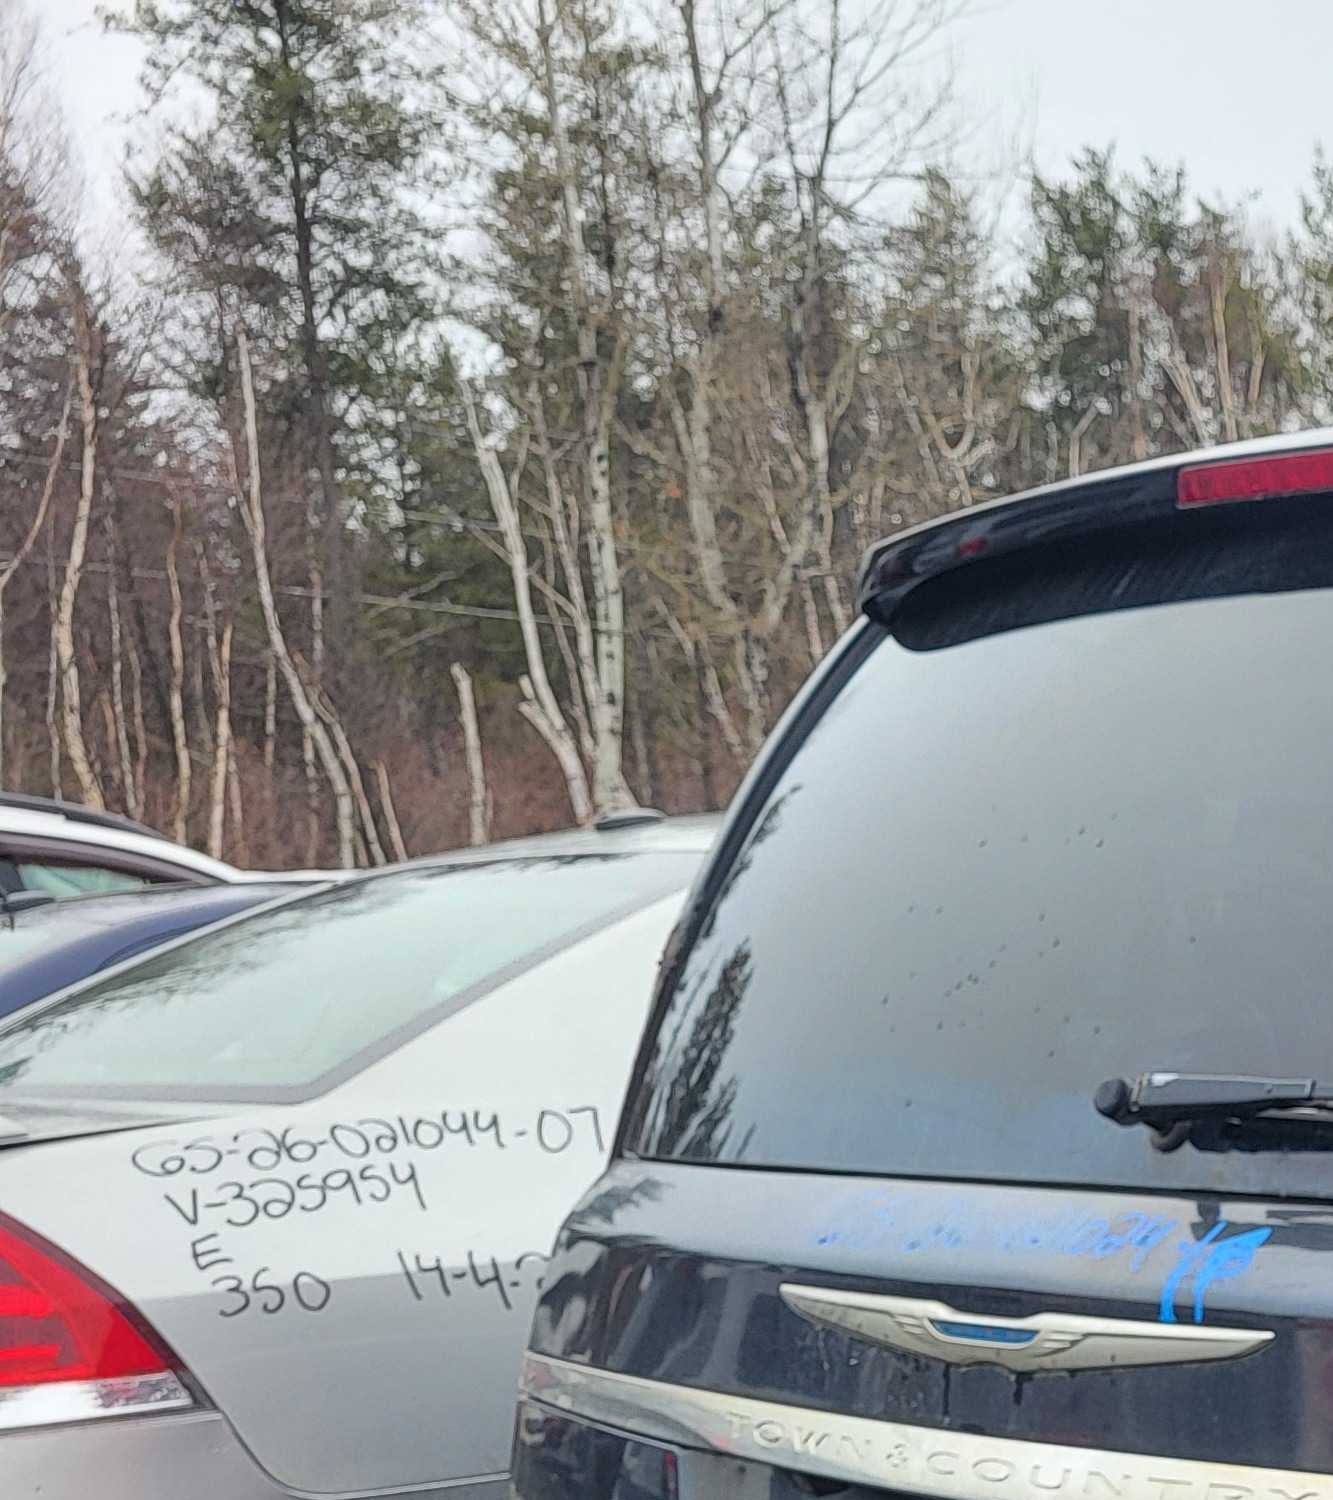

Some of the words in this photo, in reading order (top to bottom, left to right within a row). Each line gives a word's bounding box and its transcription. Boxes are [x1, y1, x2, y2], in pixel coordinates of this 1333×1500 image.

[163, 1162, 427, 1227] V-325954
[190, 1232, 233, 1271] E
[210, 1266, 332, 1317] 350
[724, 1410, 875, 1461] TOWN
[885, 1427, 910, 1469] &
